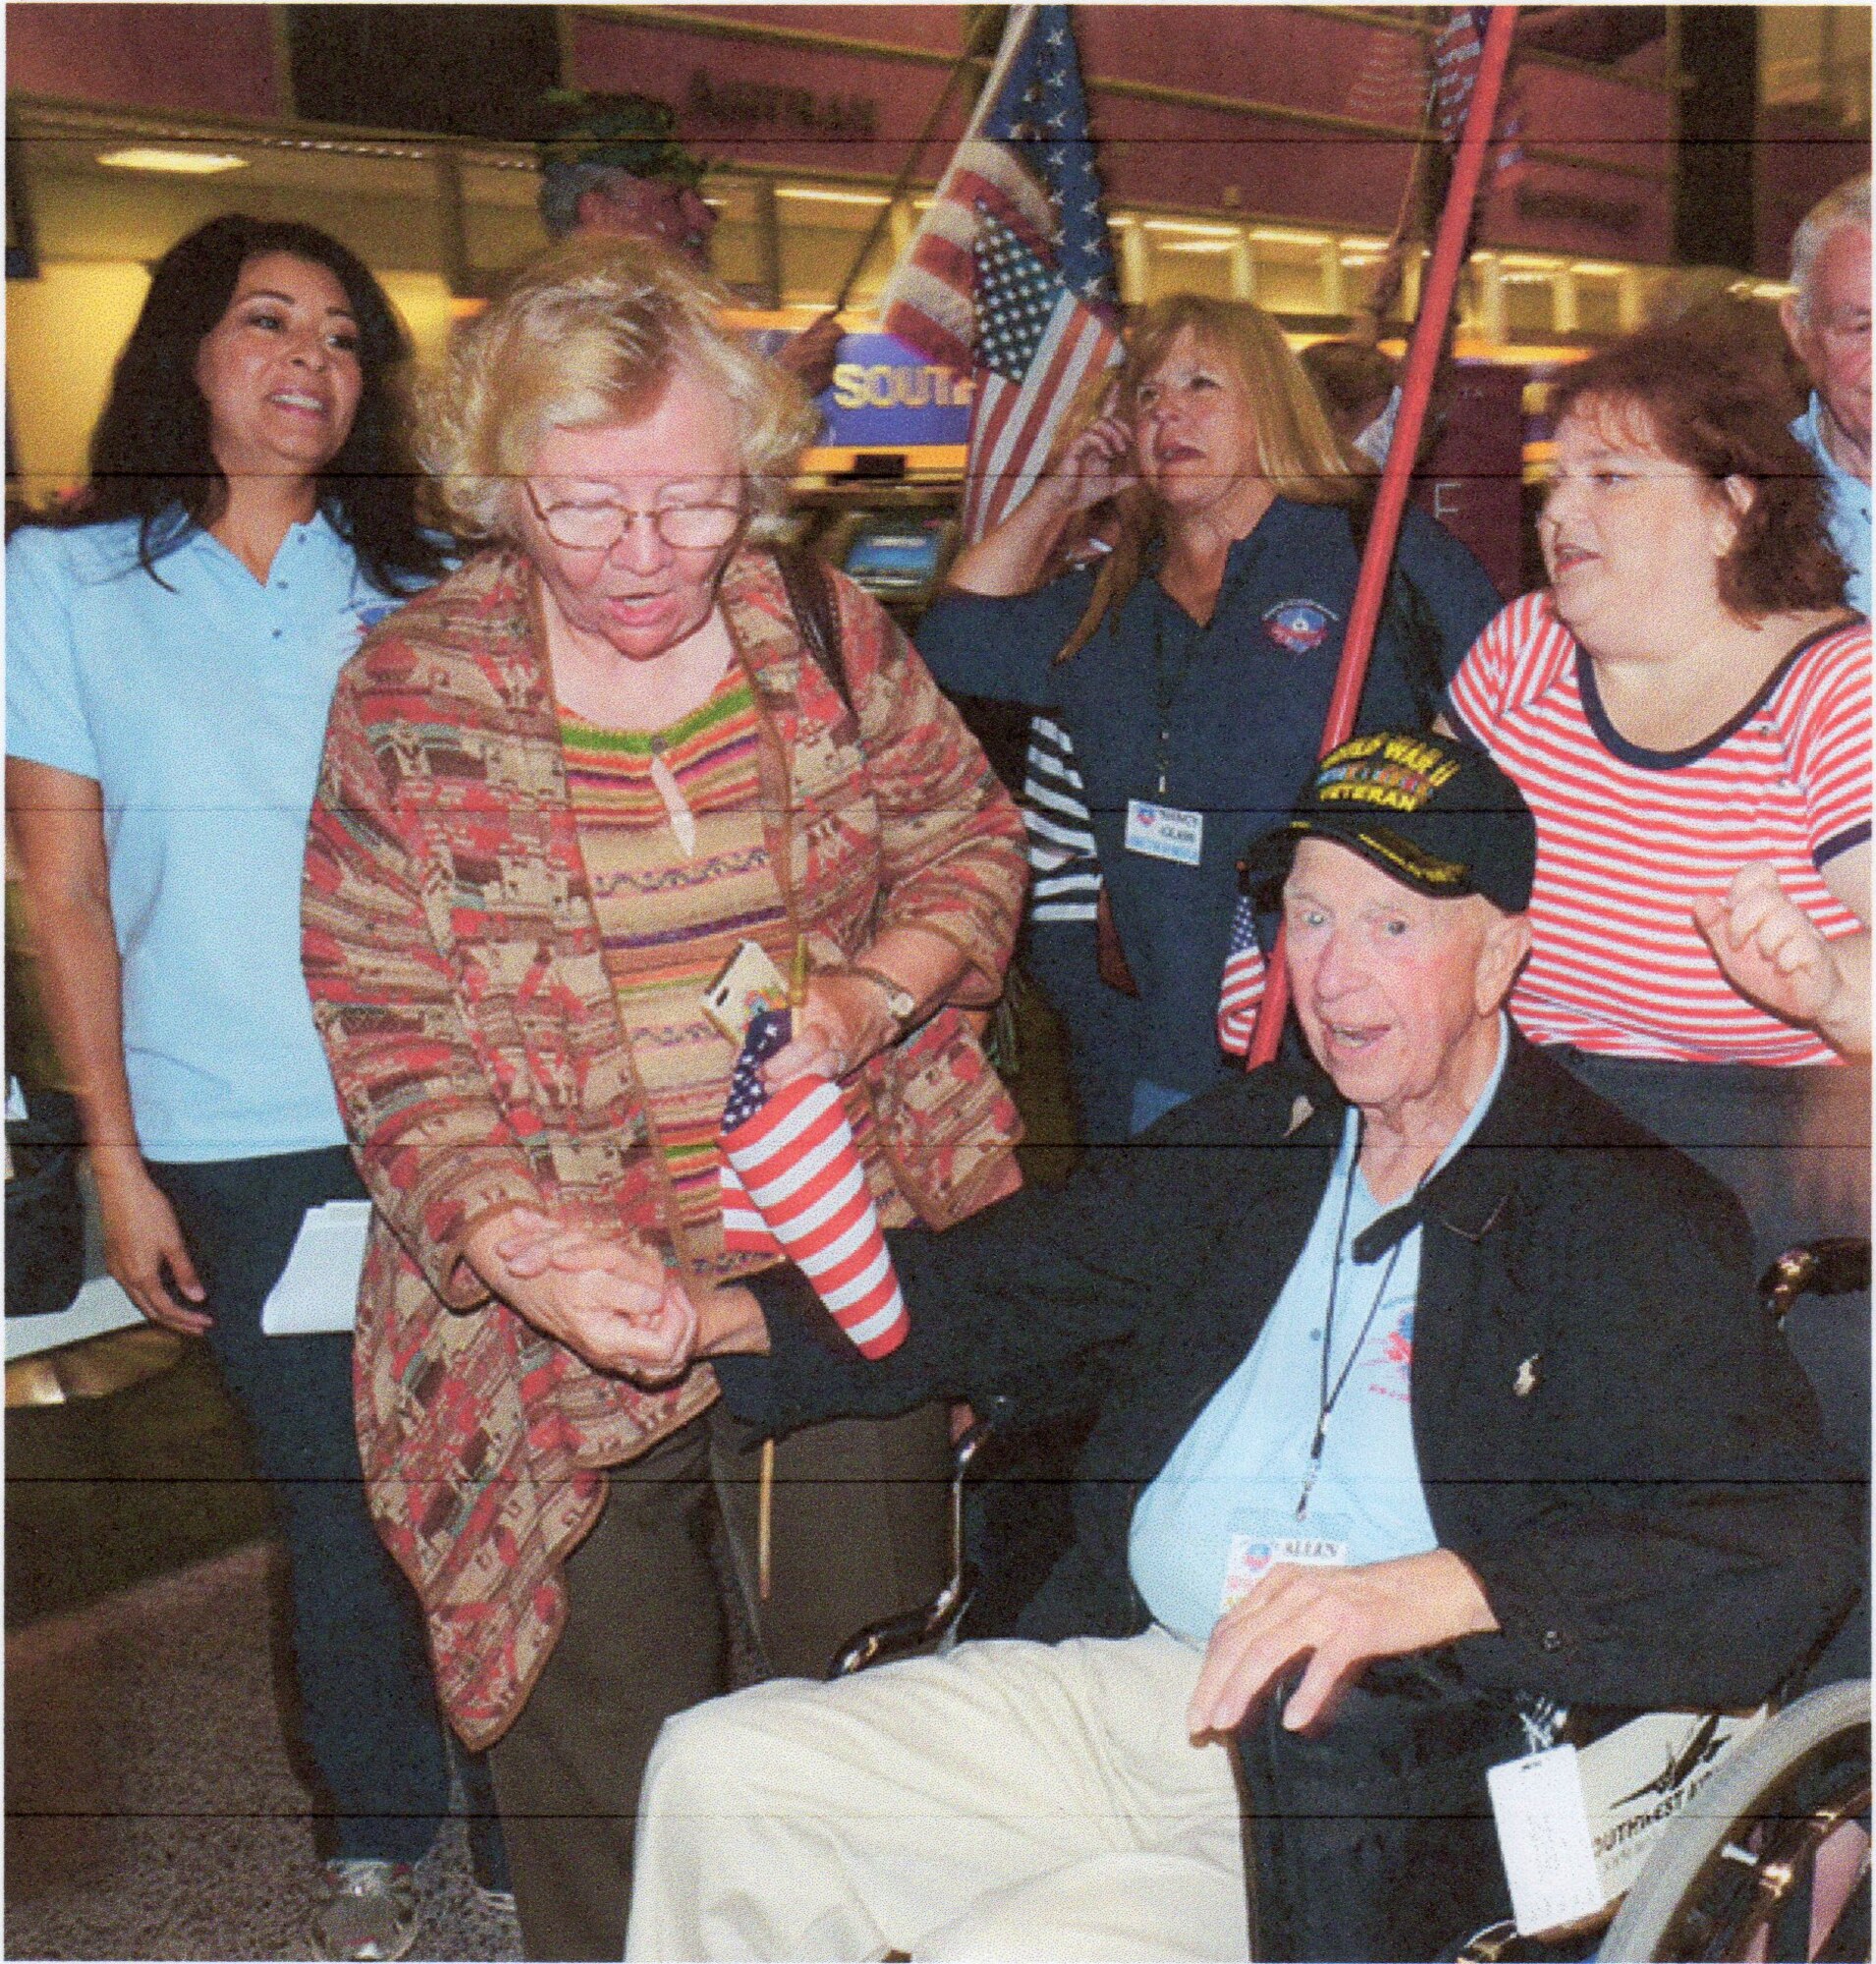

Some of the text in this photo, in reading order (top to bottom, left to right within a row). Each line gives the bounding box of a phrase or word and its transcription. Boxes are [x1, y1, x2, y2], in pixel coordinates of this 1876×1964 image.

[1384, 736, 1444, 774] WAR
[1319, 782, 1418, 812] VETERAN
[1593, 1787, 1685, 1857] OUTHWEST
